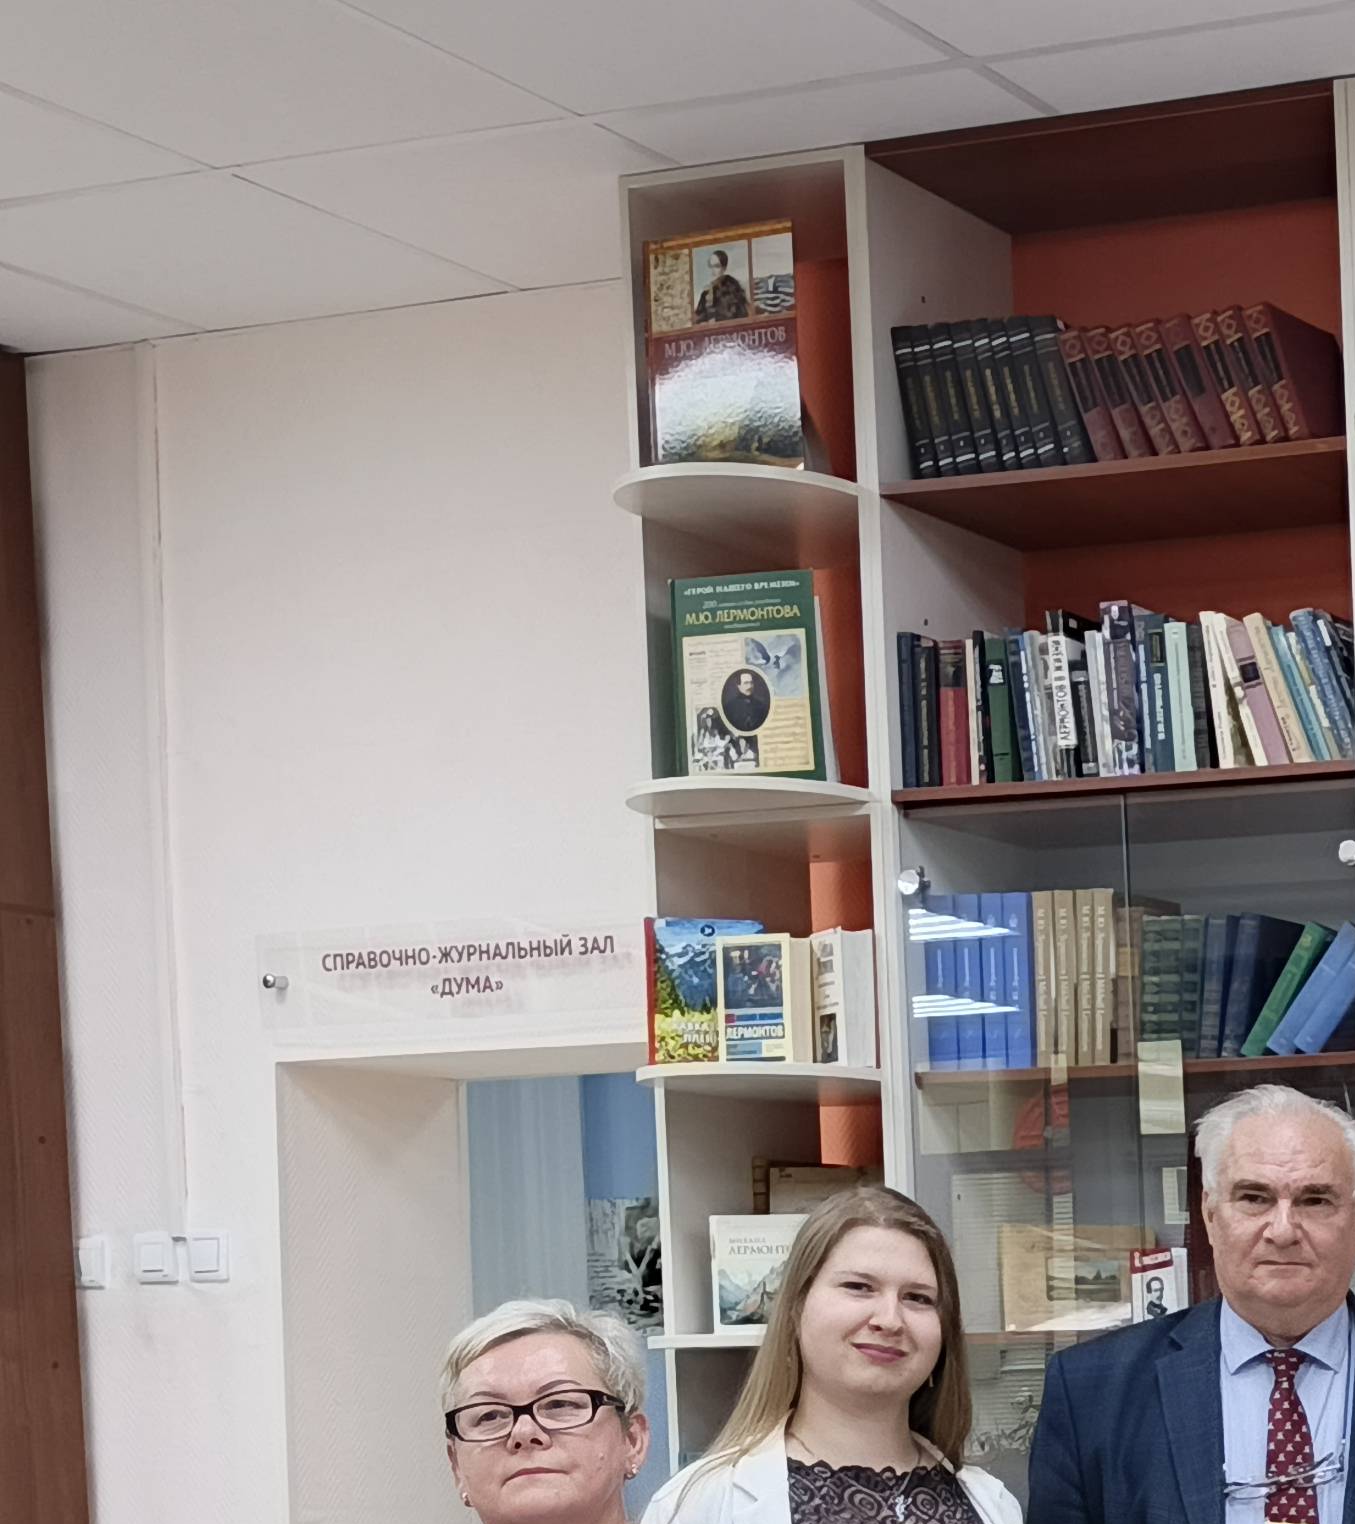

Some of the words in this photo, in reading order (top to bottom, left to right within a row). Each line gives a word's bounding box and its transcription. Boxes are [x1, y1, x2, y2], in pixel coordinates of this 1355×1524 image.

[716, 605, 800, 622] ЛЕРМОНТОВА
[322, 934, 573, 972] СПРАВОЧНО-ЖУРНАЛЬНЫЙ
[578, 935, 615, 956] ЗАЛ
[431, 975, 504, 998] «ДУМА»
[726, 1024, 784, 1040] ЛЕРМОНТОВ
